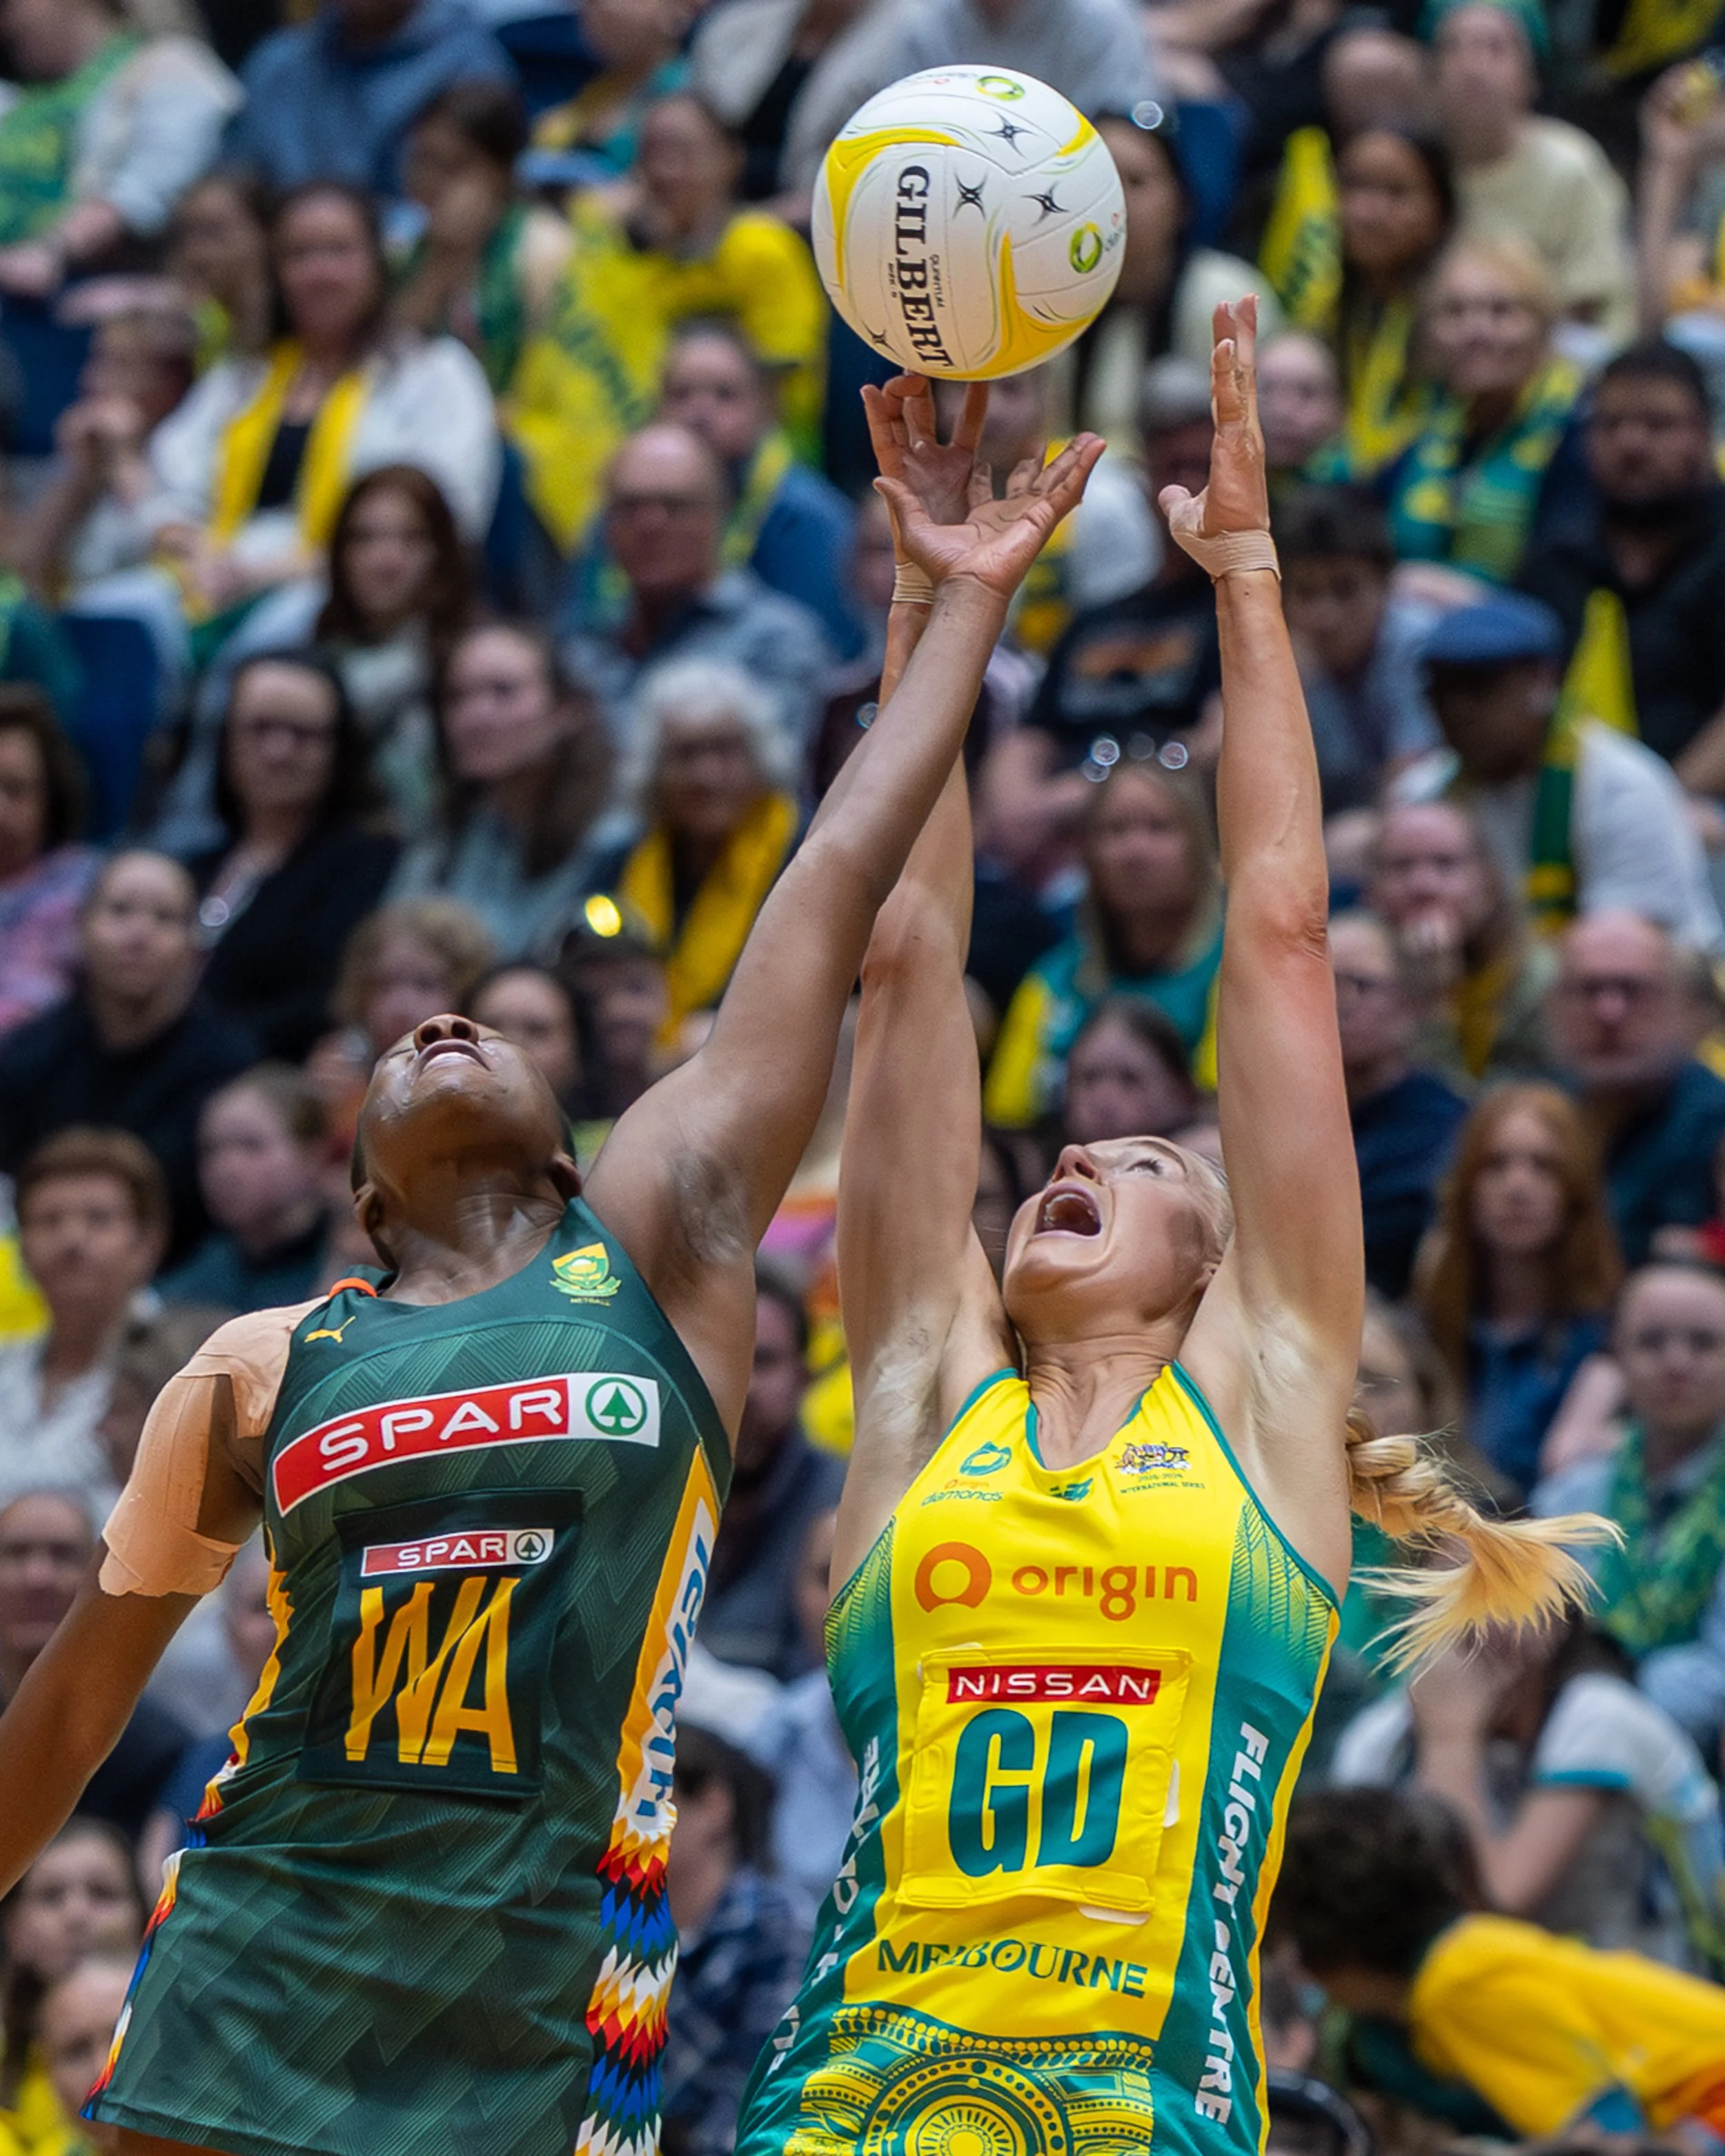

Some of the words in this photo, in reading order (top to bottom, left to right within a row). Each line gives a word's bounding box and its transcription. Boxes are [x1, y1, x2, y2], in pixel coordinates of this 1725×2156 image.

[896, 166, 954, 368] GILBERT
[319, 1389, 563, 1471] SPAR
[397, 1537, 505, 1567] SPAR
[1012, 1565, 1198, 1621] origin
[345, 1576, 521, 1774] WA
[956, 1673, 1151, 1699] NISSAN
[948, 1708, 1129, 1877] GD
